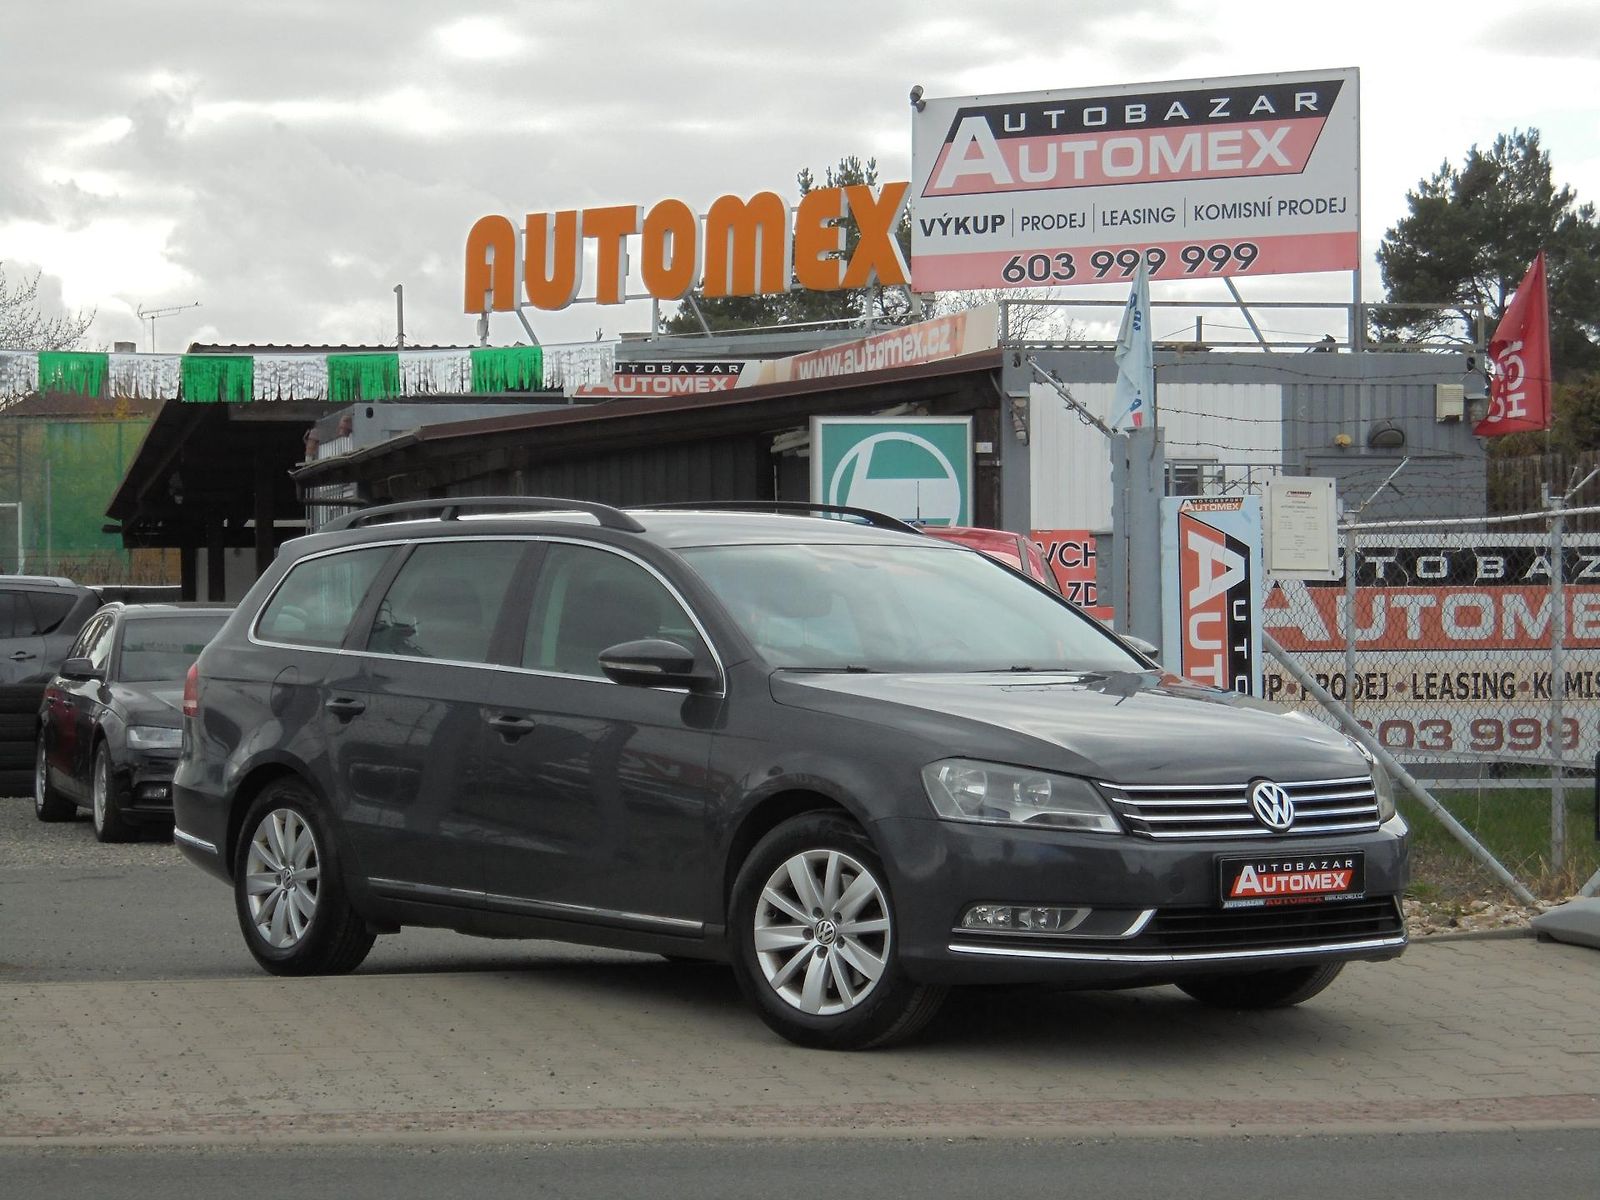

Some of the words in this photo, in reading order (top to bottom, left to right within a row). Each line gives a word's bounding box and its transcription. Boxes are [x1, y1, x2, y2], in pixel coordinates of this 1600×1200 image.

[933, 115, 1293, 190] AUTOMEX
[919, 212, 1006, 238] VÝKUP
[1021, 211, 1086, 232] PRODEJ
[1102, 206, 1176, 227] LEASING
[1194, 196, 1273, 222] KOMISNÍ
[1277, 197, 1347, 217] PRODEJ
[464, 182, 911, 314] AUTOMEX
[1002, 252, 1077, 283] 603
[1090, 247, 1167, 281] 999
[1180, 242, 1259, 275] 999
[800, 323, 951, 379] www.automex.cz
[1180, 500, 1240, 511] AUTOMEX
[1412, 671, 1516, 700] LEASING
[1235, 865, 1346, 894] AUTOMEX
